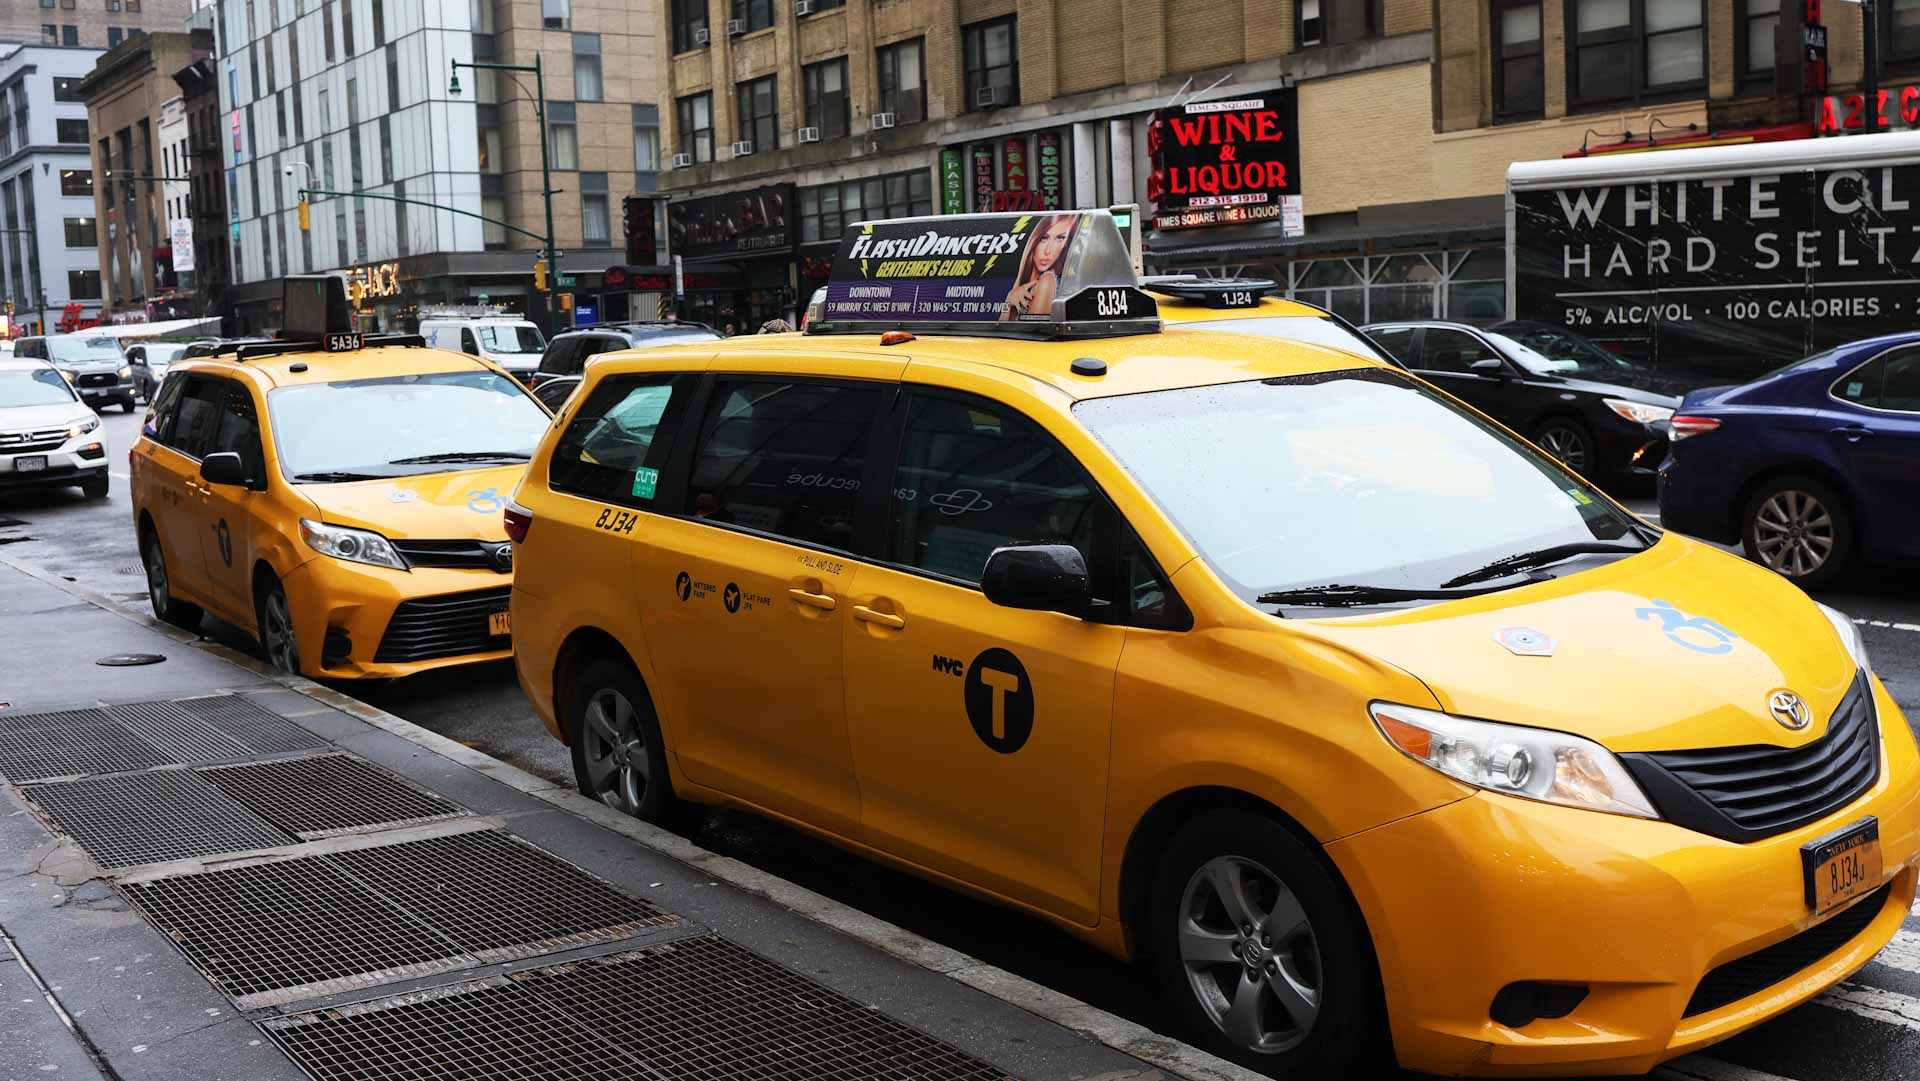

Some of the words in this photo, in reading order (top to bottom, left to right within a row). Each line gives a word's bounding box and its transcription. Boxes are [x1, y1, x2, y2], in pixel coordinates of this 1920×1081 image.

[1169, 111, 1283, 147] WINE
[1219, 145, 1236, 162] &
[1169, 161, 1288, 196] LIQUOR
[1556, 174, 1781, 229] WHITE
[1157, 216, 1180, 229] TIMES
[1181, 212, 1215, 225] SQUARE
[1216, 209, 1239, 221] WINE
[1239, 210, 1247, 219] &
[1564, 236, 1716, 279] HARD
[876, 260, 938, 278] GENTLEMEN'S
[937, 259, 976, 277] CLUBS
[849, 286, 892, 298] DOWNTOWN
[945, 286, 985, 298] MIDTOWN
[1222, 292, 1252, 305] 1J24
[828, 302, 836, 313] 59
[836, 302, 862, 313] MURRAY
[918, 302, 931, 313] 320
[963, 302, 979, 313] BTW
[1097, 289, 1128, 316] 8J34
[1565, 307, 1592, 325] 5%
[1604, 303, 1693, 325] ALC/VOL
[1725, 302, 1760, 320] 100
[1767, 298, 1880, 320] CALORIES
[331, 335, 360, 350] 5A36
[635, 470, 658, 485] curb
[595, 508, 639, 534] 8J34
[932, 654, 963, 677] NYC
[980, 666, 1019, 740] T
